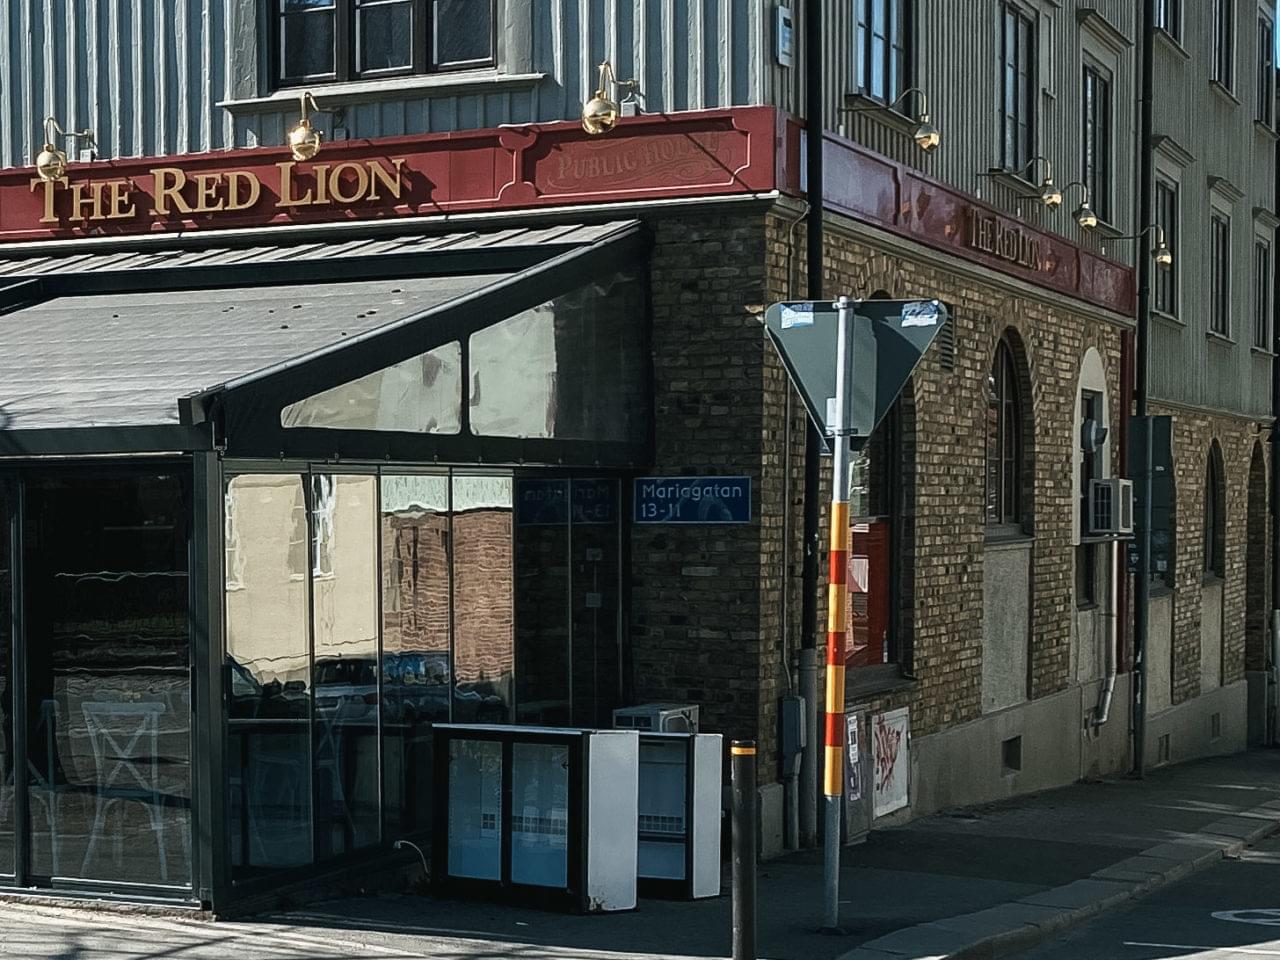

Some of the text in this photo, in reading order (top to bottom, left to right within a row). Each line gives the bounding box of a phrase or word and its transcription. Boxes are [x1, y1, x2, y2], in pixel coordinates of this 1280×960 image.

[30, 158, 406, 223] THE RED LION
[971, 206, 993, 252] THE
[995, 216, 1016, 261] RED
[641, 502, 681, 518] 13-11
[642, 483, 742, 501] Mariagatan
